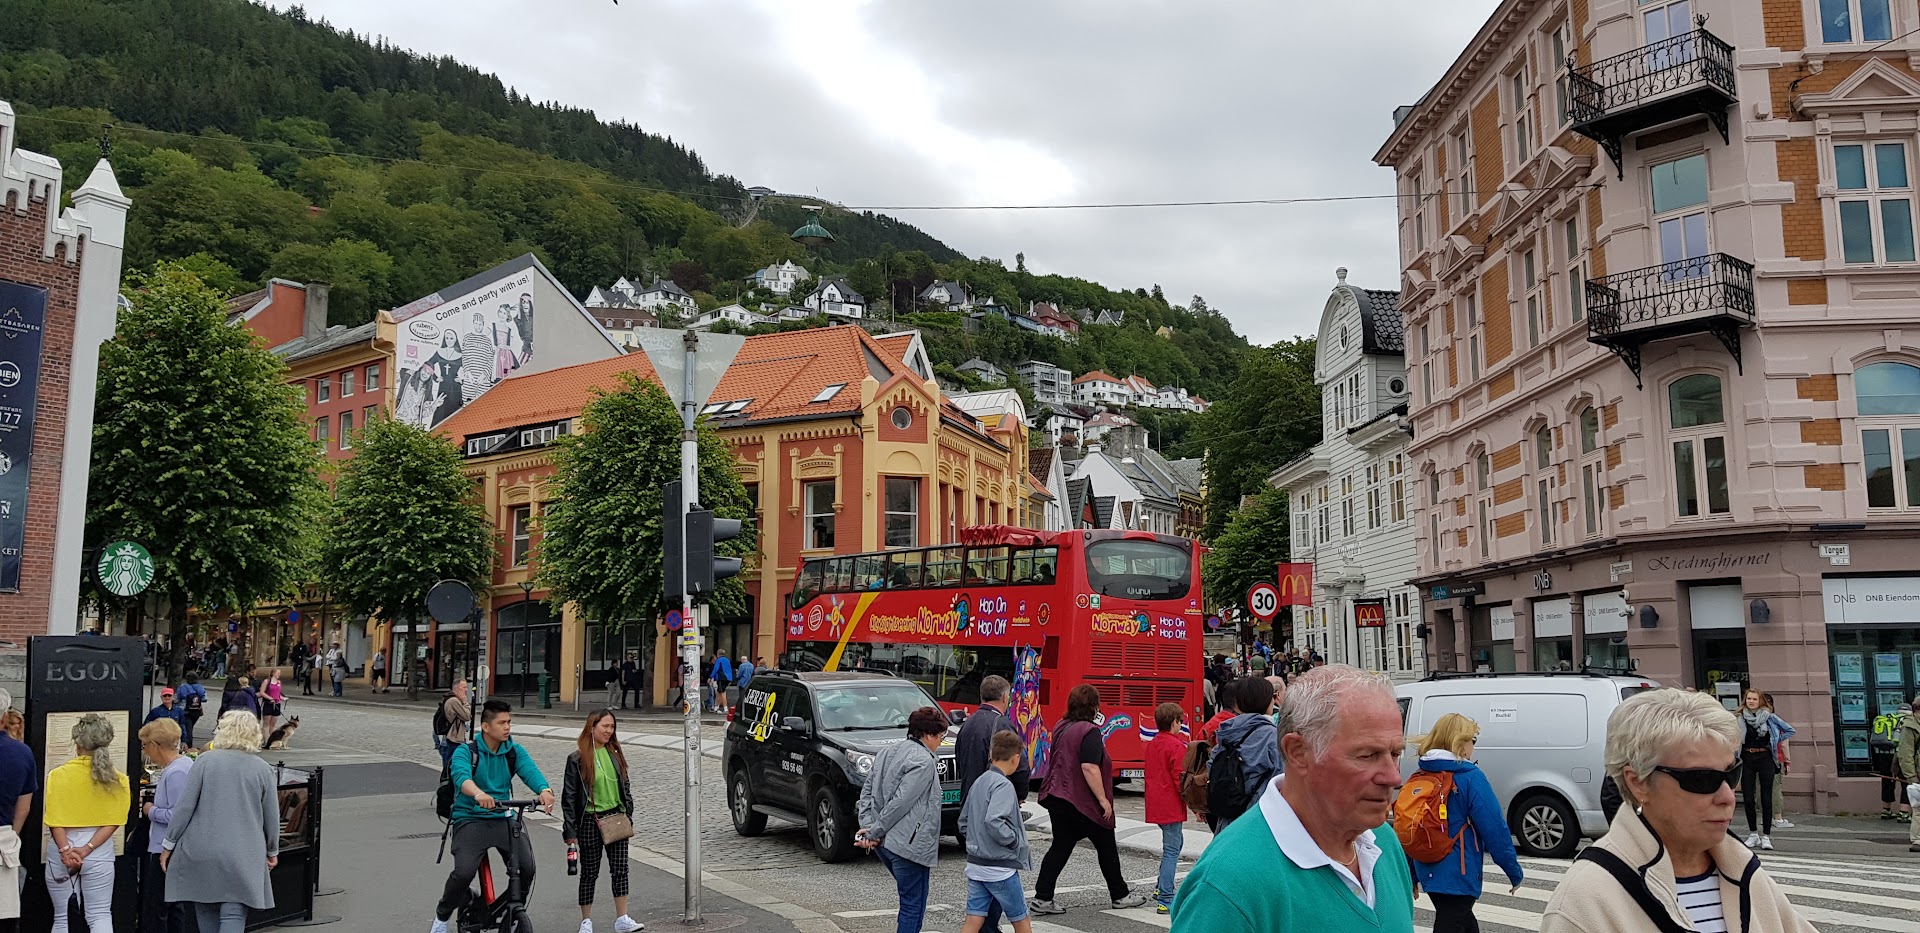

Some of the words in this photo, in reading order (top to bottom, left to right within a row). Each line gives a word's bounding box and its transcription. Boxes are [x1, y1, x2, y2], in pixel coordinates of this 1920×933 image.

[435, 306, 461, 321] Come
[461, 297, 478, 311] and
[477, 288, 499, 306] party
[498, 281, 517, 294] with
[516, 274, 530, 286] us!
[0, 412, 21, 425] 77
[1824, 546, 1846, 555] Torget
[1534, 568, 1550, 593] DNB
[1452, 586, 1476, 594] Minibank
[1833, 594, 1857, 604] DNB
[1865, 594, 1884, 602] DNB
[1885, 593, 1920, 602] Eiendom
[979, 598, 995, 615] Hop
[995, 596, 1007, 613] On
[1255, 592, 1275, 610] 30
[917, 606, 961, 639] Norway
[977, 619, 993, 636] Hop
[994, 618, 1008, 635] Off
[1092, 613, 1140, 636] Norway
[1160, 617, 1174, 627] Hop
[1175, 618, 1185, 627] On
[1160, 629, 1174, 638] Hop
[1175, 630, 1186, 639] Off
[46, 661, 129, 681] EGON
